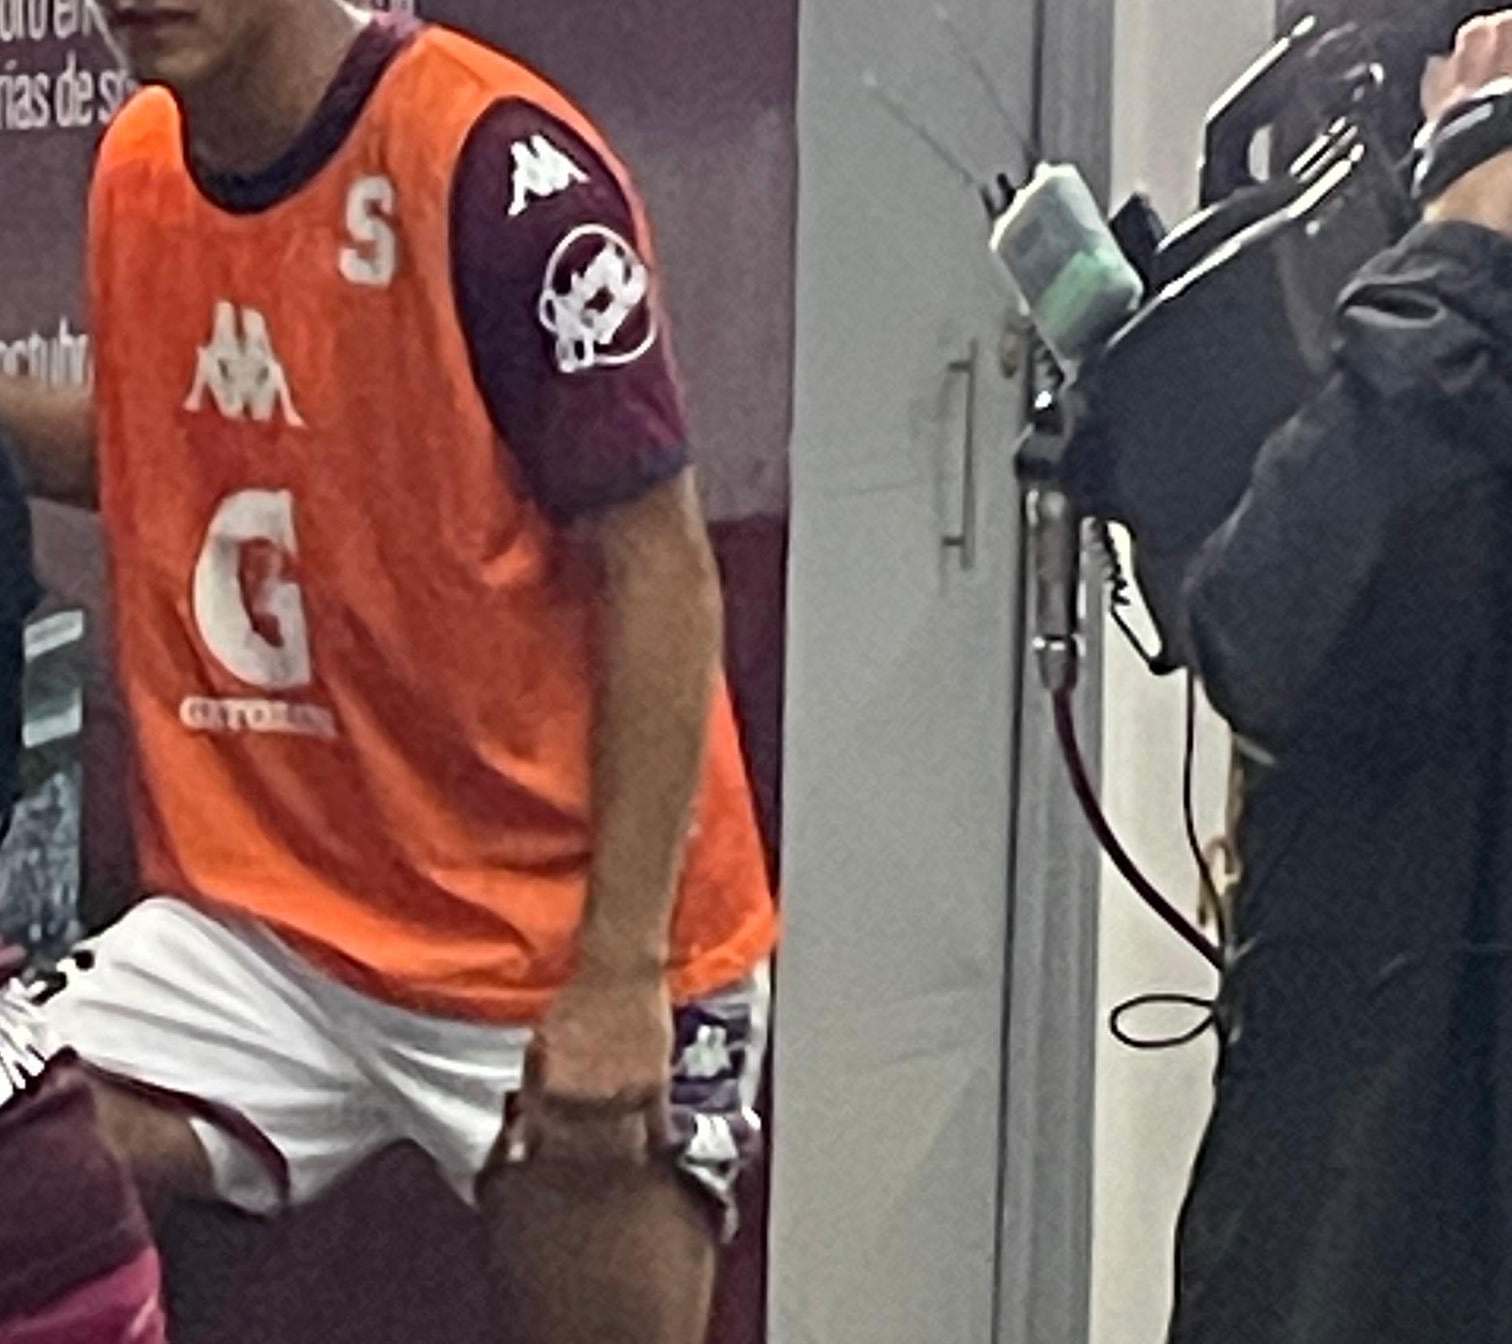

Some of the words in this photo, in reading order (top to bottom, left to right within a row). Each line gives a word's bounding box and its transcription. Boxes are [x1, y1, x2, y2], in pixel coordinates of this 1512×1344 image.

[55, 49, 94, 127] de
[338, 174, 399, 288] S
[193, 487, 312, 691] G
